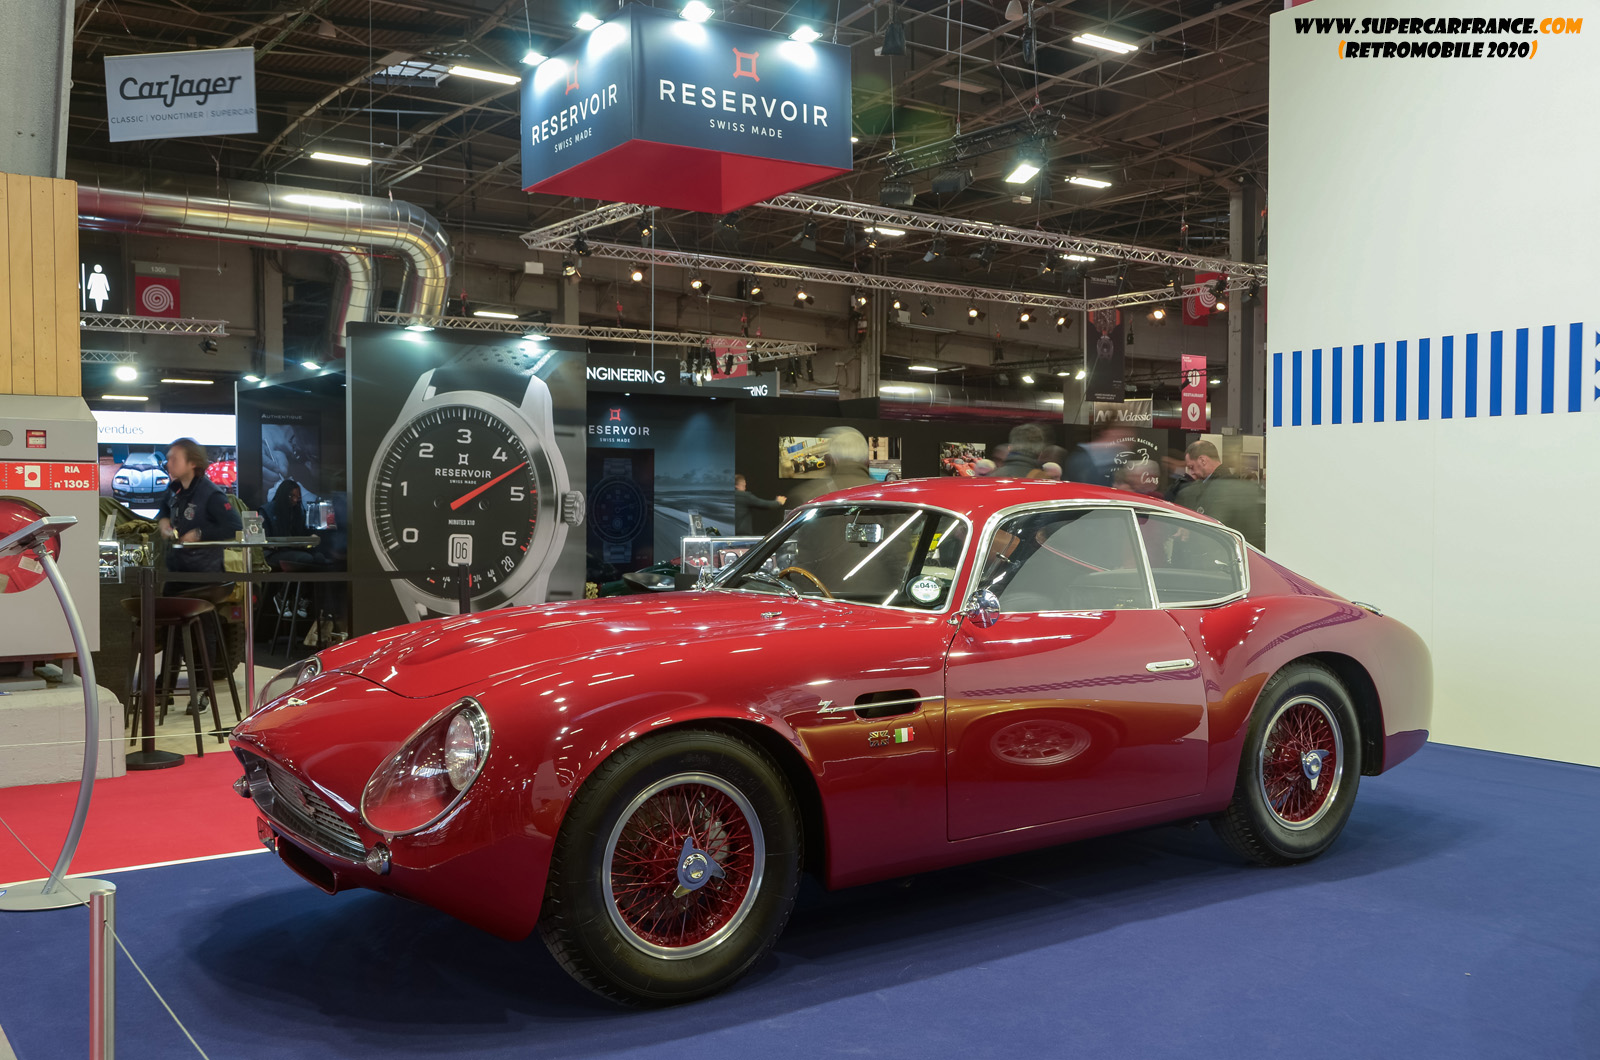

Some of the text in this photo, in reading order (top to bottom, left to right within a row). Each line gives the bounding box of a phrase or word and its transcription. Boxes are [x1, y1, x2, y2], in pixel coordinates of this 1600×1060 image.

[119, 74, 242, 108] CarJager
[659, 79, 828, 127] RESERVOIR
[111, 107, 255, 124] CLASSIC YOUNGTIMER SUPERCAR
[531, 83, 618, 146] RESERVOIR
[709, 118, 783, 139] SWISS MADE
[554, 127, 593, 153] SWISS MADE
[586, 366, 666, 384] NGINEERING
[98, 424, 144, 435] vendues
[457, 428, 472, 444] 3
[588, 424, 650, 436] ESERVOIR
[419, 443, 434, 458] 2
[492, 447, 508, 462] 4
[64, 465, 80, 474] RIA
[434, 467, 492, 479] RESERVOIR
[400, 481, 408, 497] 1
[510, 486, 525, 501] 5
[501, 531, 517, 546] 6
[455, 541, 468, 560] 06
[500, 555, 515, 573] 28
